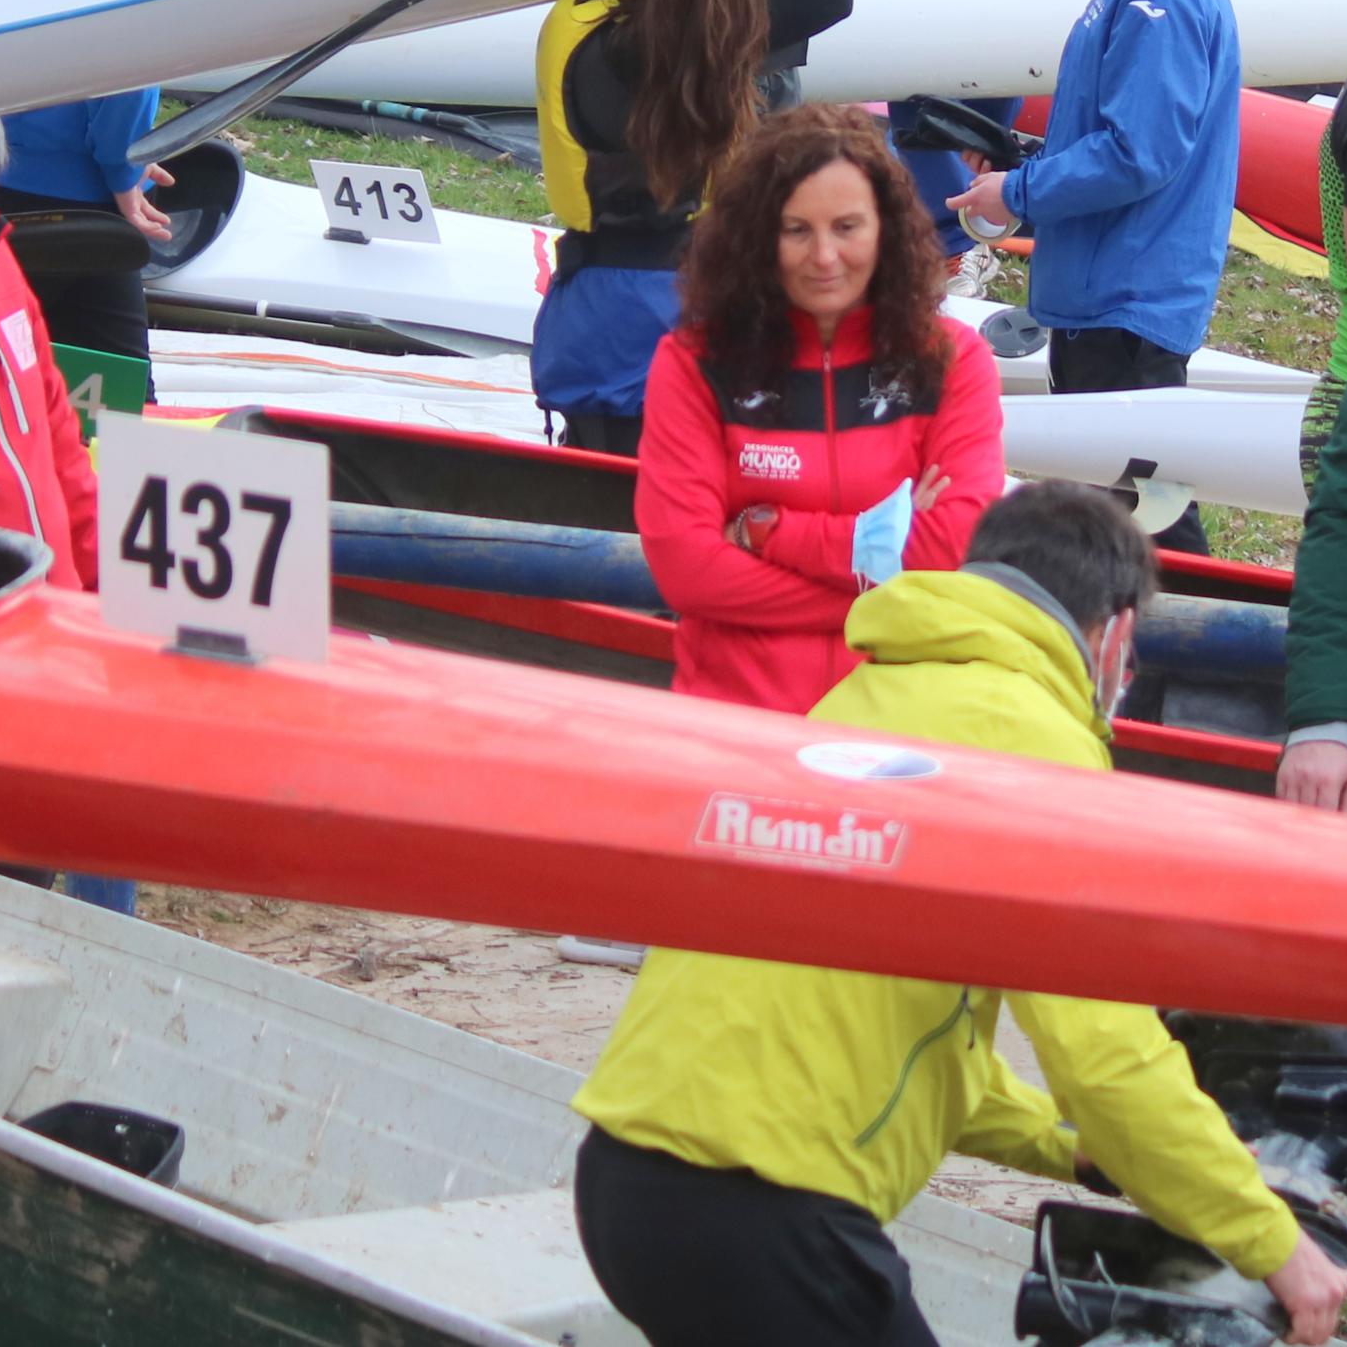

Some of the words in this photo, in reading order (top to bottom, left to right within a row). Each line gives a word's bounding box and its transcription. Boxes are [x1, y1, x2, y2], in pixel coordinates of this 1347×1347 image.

[334, 177, 423, 223] 413
[739, 452, 801, 470] MUNDO
[120, 474, 292, 607] 437
